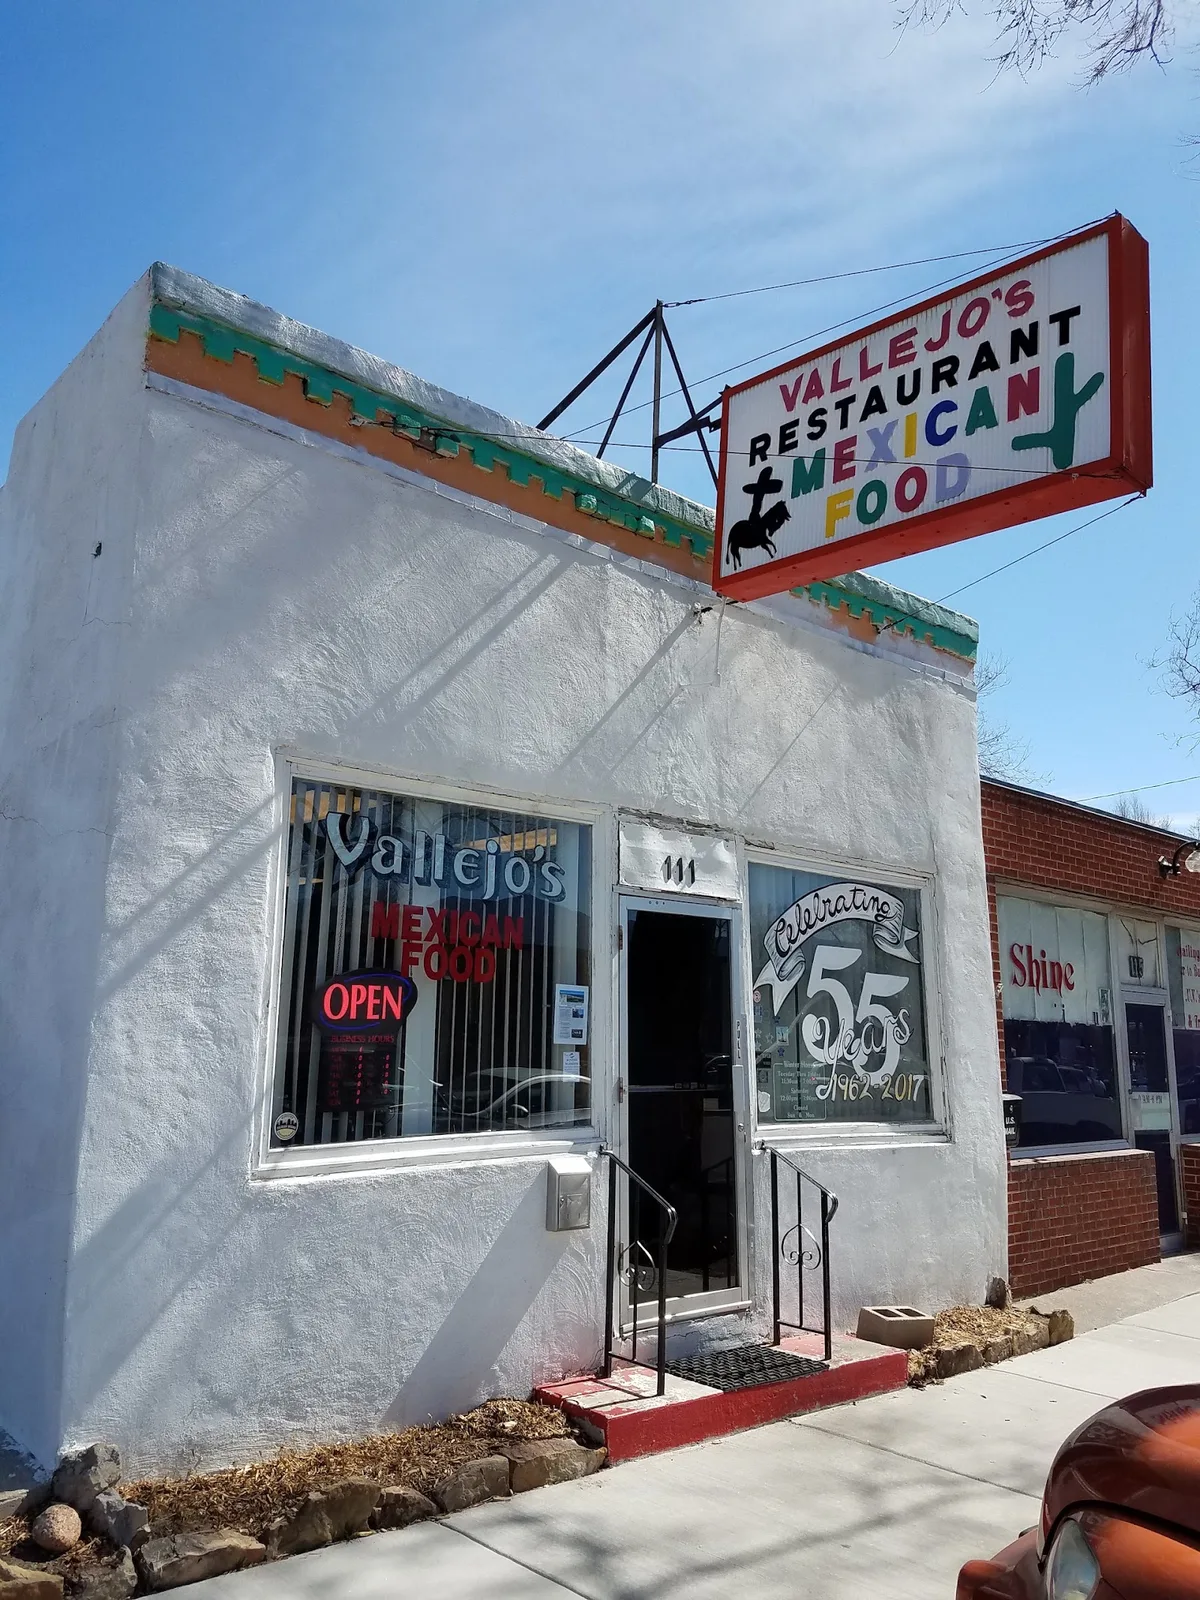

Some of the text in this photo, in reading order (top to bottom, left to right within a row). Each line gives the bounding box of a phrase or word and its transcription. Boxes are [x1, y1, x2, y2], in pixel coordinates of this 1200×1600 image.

[779, 280, 1035, 413] VALLEJO'S
[749, 305, 1081, 467] RESTAURANT
[791, 366, 1040, 499] MEXICAN
[825, 451, 971, 539] FOOD
[326, 811, 566, 901] Vallejo's
[664, 855, 696, 885] 111
[371, 901, 524, 950] MEXICAN
[774, 886, 897, 958] Celebrating
[402, 942, 496, 983] FOOD
[1009, 942, 1075, 997] Shine
[322, 982, 404, 1021] OPEN
[801, 944, 909, 1085] 55
[331, 1034, 395, 1043] BUSINESS HOURS
[812, 1008, 913, 1100] Years
[831, 1073, 925, 1101] 1962-2017
